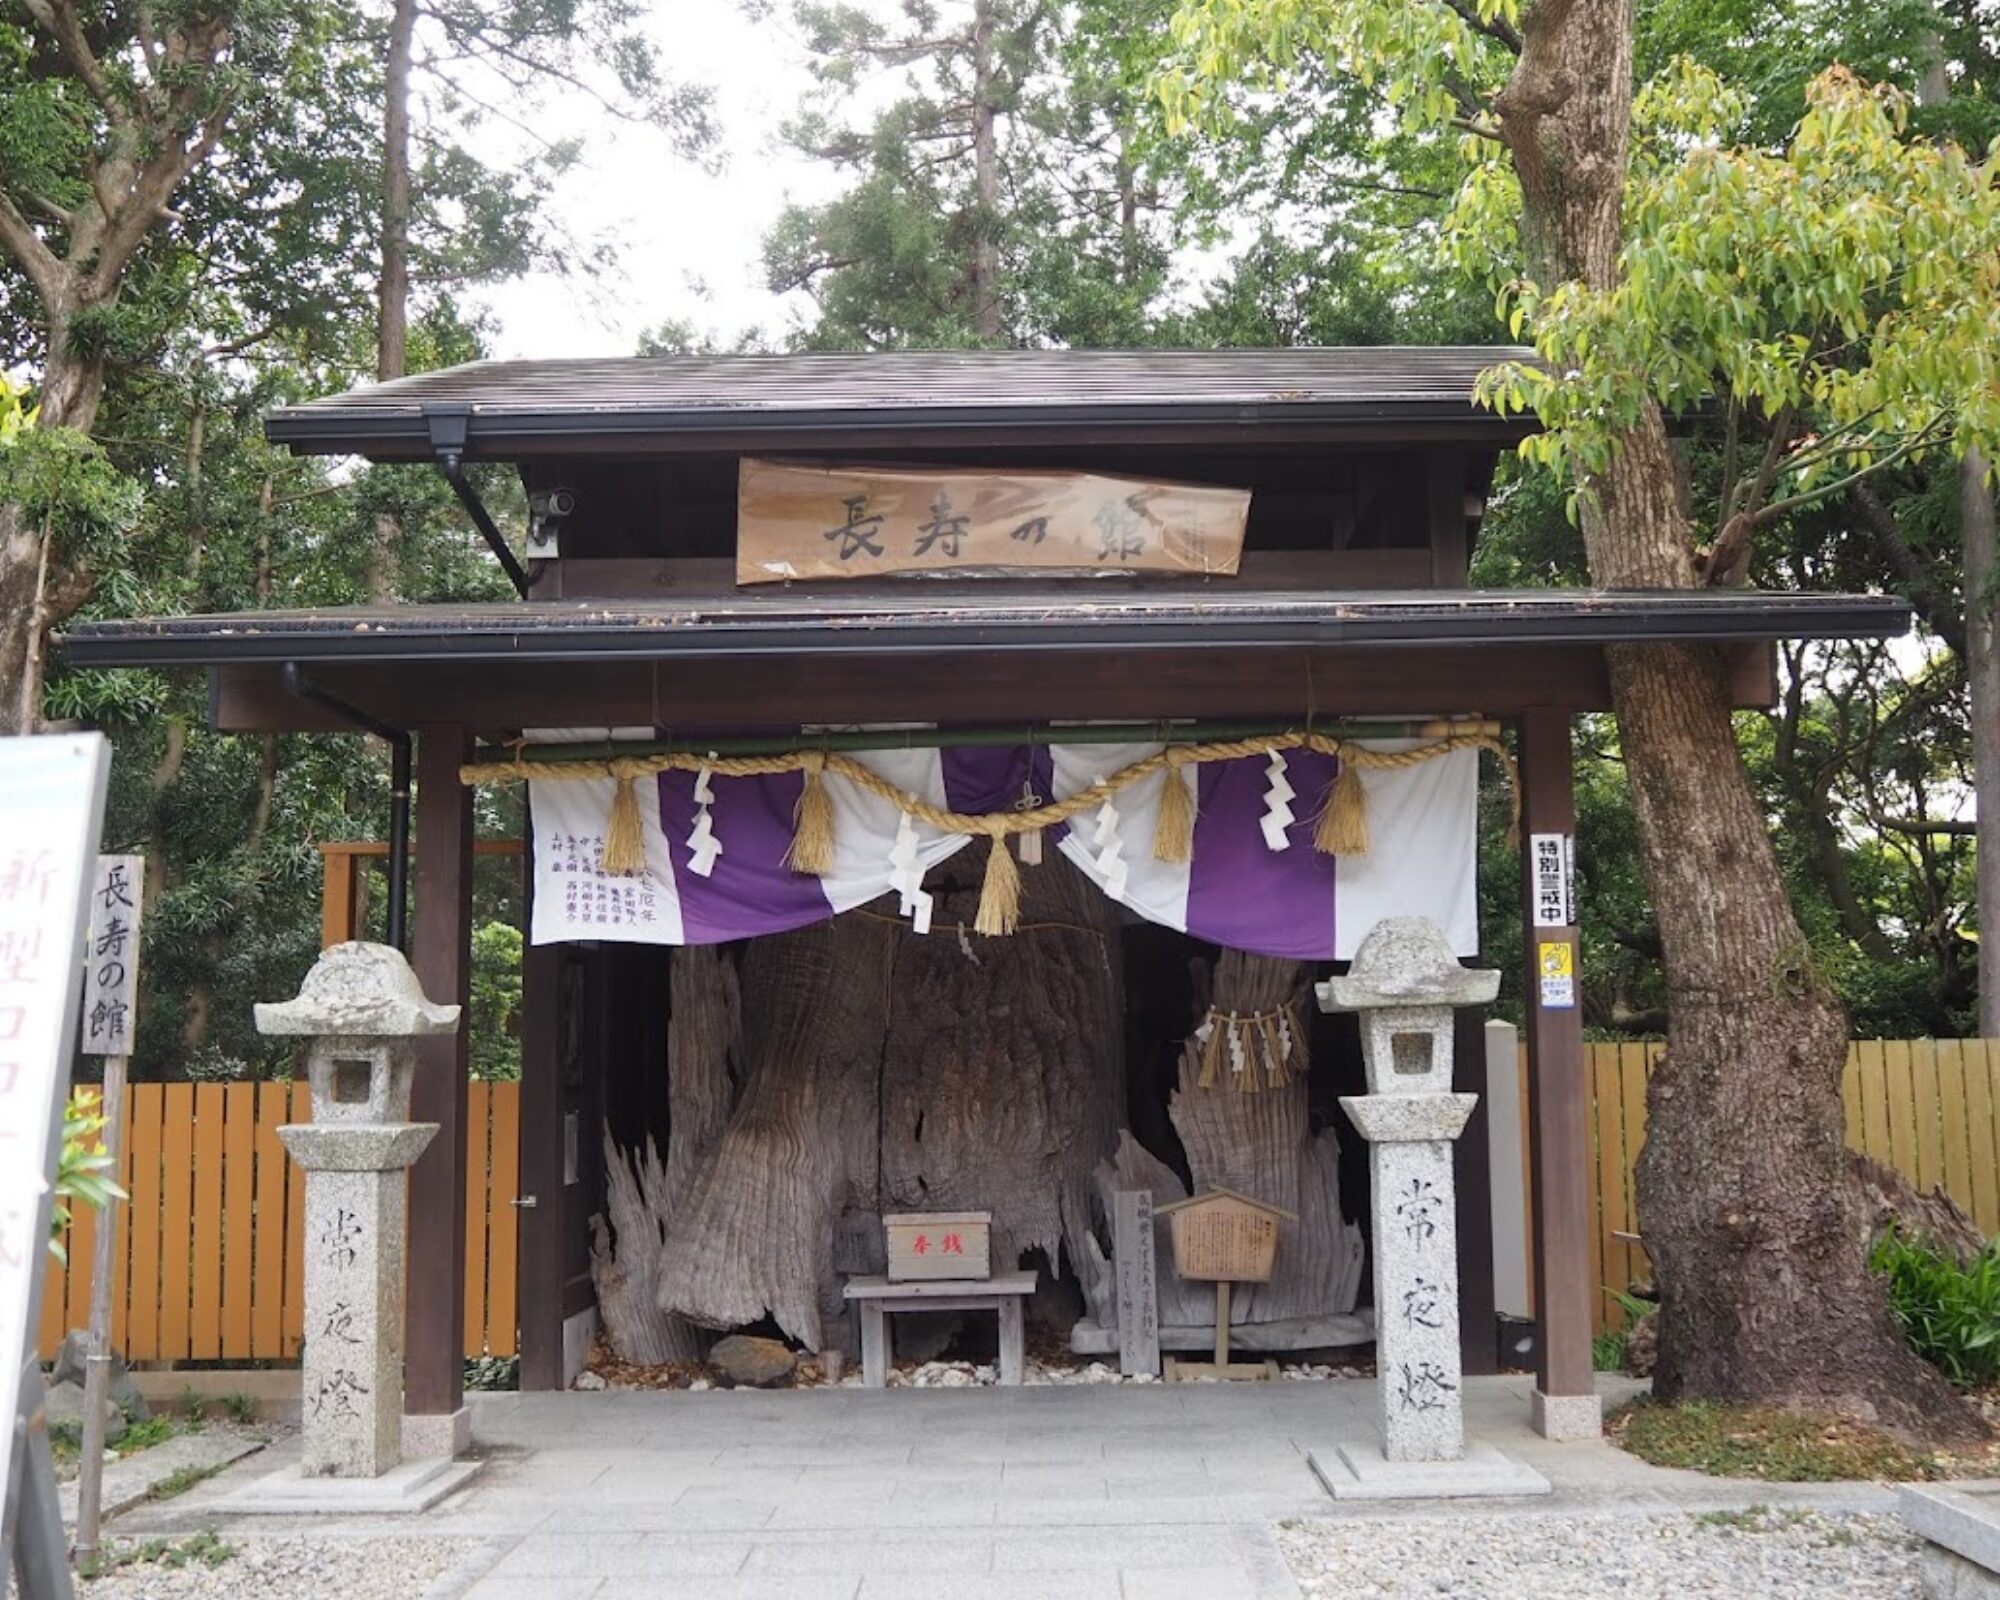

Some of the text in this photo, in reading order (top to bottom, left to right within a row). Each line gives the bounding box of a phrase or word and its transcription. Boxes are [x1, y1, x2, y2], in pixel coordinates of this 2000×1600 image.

[89, 865, 135, 1038] 長寿の館
[1538, 840, 1561, 922] 特別警戒中
[308, 1207, 369, 1418] 常夜燈
[1396, 1178, 1456, 1411] 常夜燈
